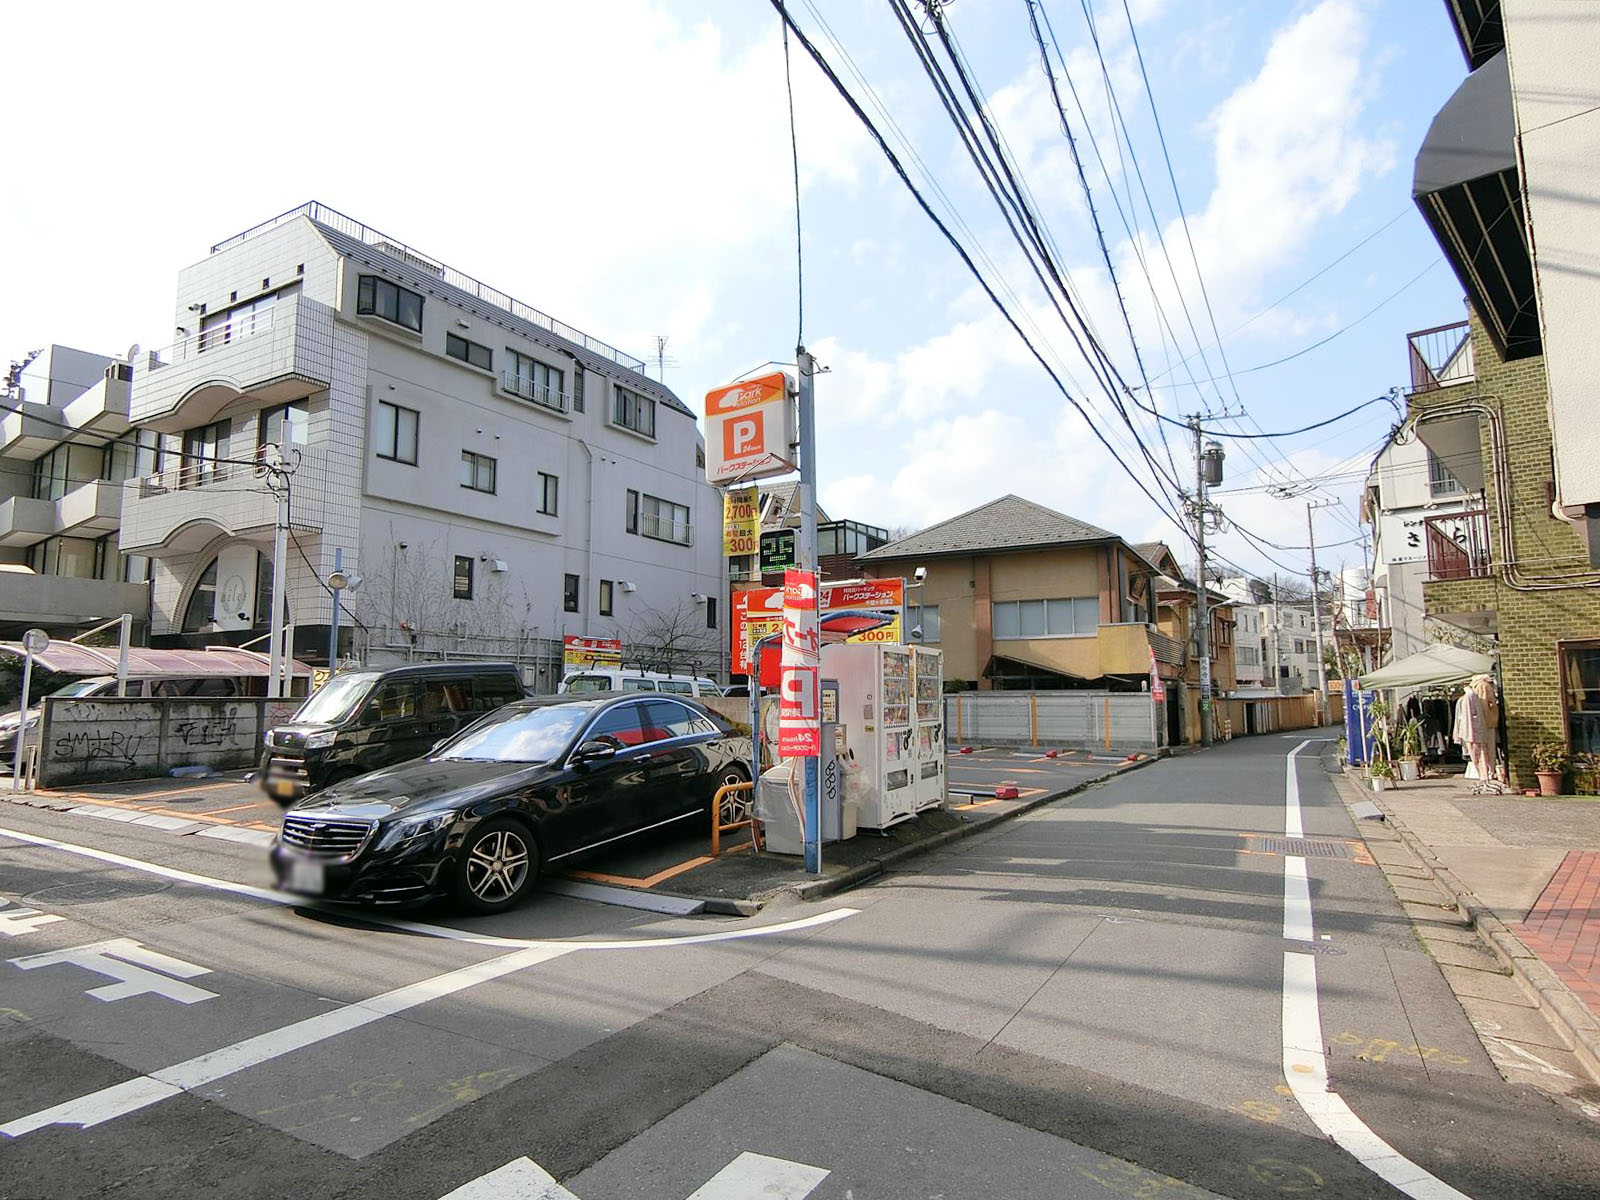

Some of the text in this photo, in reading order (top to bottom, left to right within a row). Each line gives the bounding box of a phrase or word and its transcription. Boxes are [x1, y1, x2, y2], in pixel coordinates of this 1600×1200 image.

[738, 386, 762, 401] Park
[733, 420, 757, 455] P
[717, 457, 772, 475] パークステーション
[843, 591, 894, 600] パークステーション
[859, 630, 894, 642] 300円
